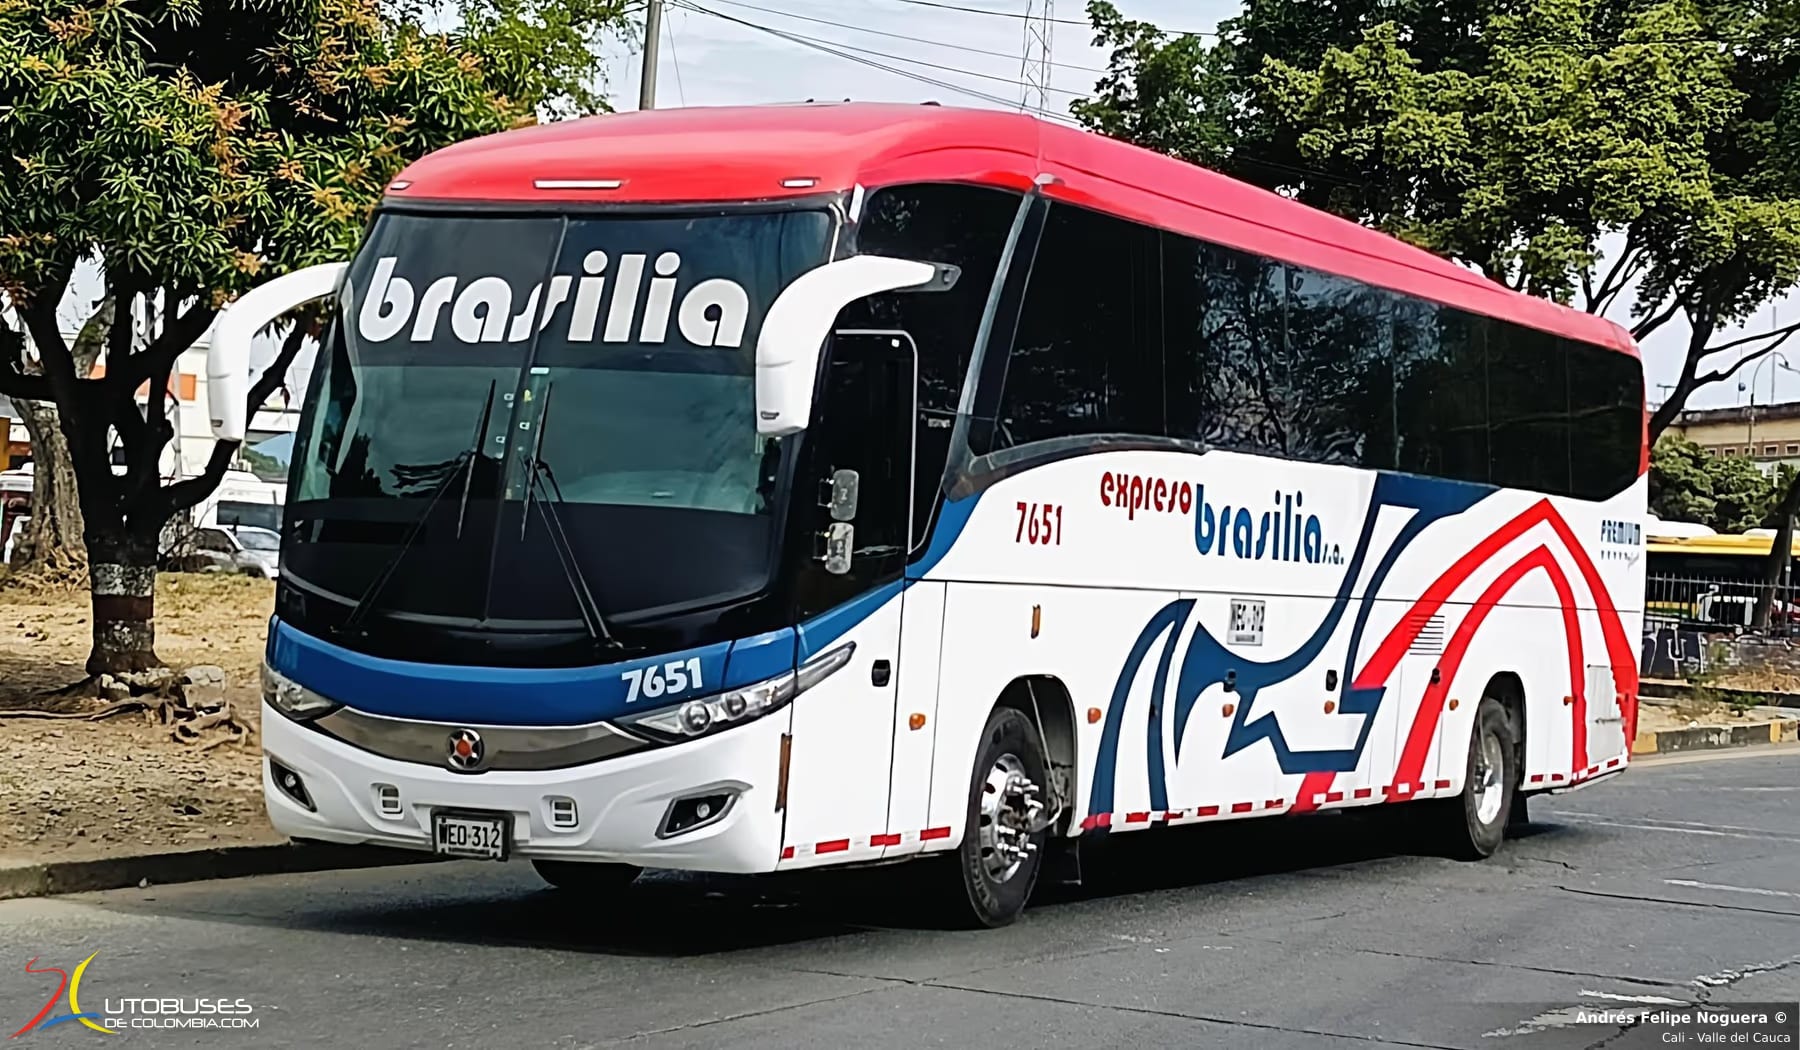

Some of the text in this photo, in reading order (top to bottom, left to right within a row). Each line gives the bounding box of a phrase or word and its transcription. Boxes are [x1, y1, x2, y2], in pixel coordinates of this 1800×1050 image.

[358, 250, 749, 348] brasilia
[1100, 471, 1192, 520] expreso
[1015, 502, 1062, 545] 7651
[1194, 484, 1322, 564] brasilia
[621, 656, 703, 703] 7651
